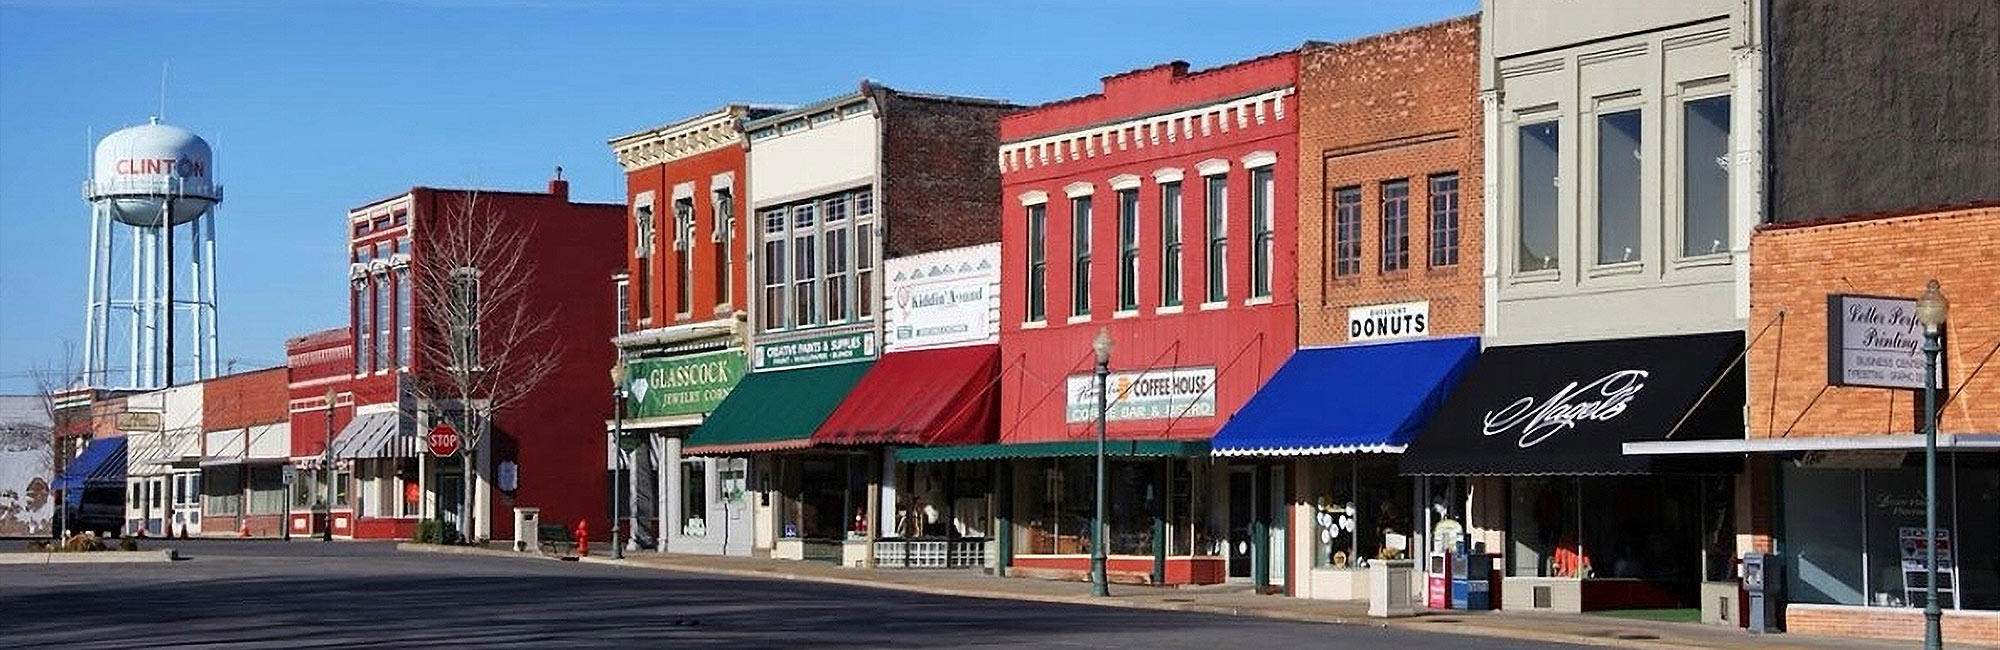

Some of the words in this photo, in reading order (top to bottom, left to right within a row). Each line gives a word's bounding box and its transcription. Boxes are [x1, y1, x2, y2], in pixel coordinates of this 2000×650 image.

[116, 158, 205, 178] CLINTON
[1351, 313, 1426, 338] DONUTS
[1862, 327, 1919, 357] Printing
[650, 360, 728, 390] GLASSCOCK
[1133, 377, 1171, 397] COFFEE
[1172, 375, 1207, 396] HOUSE
[430, 433, 457, 448] STOP
